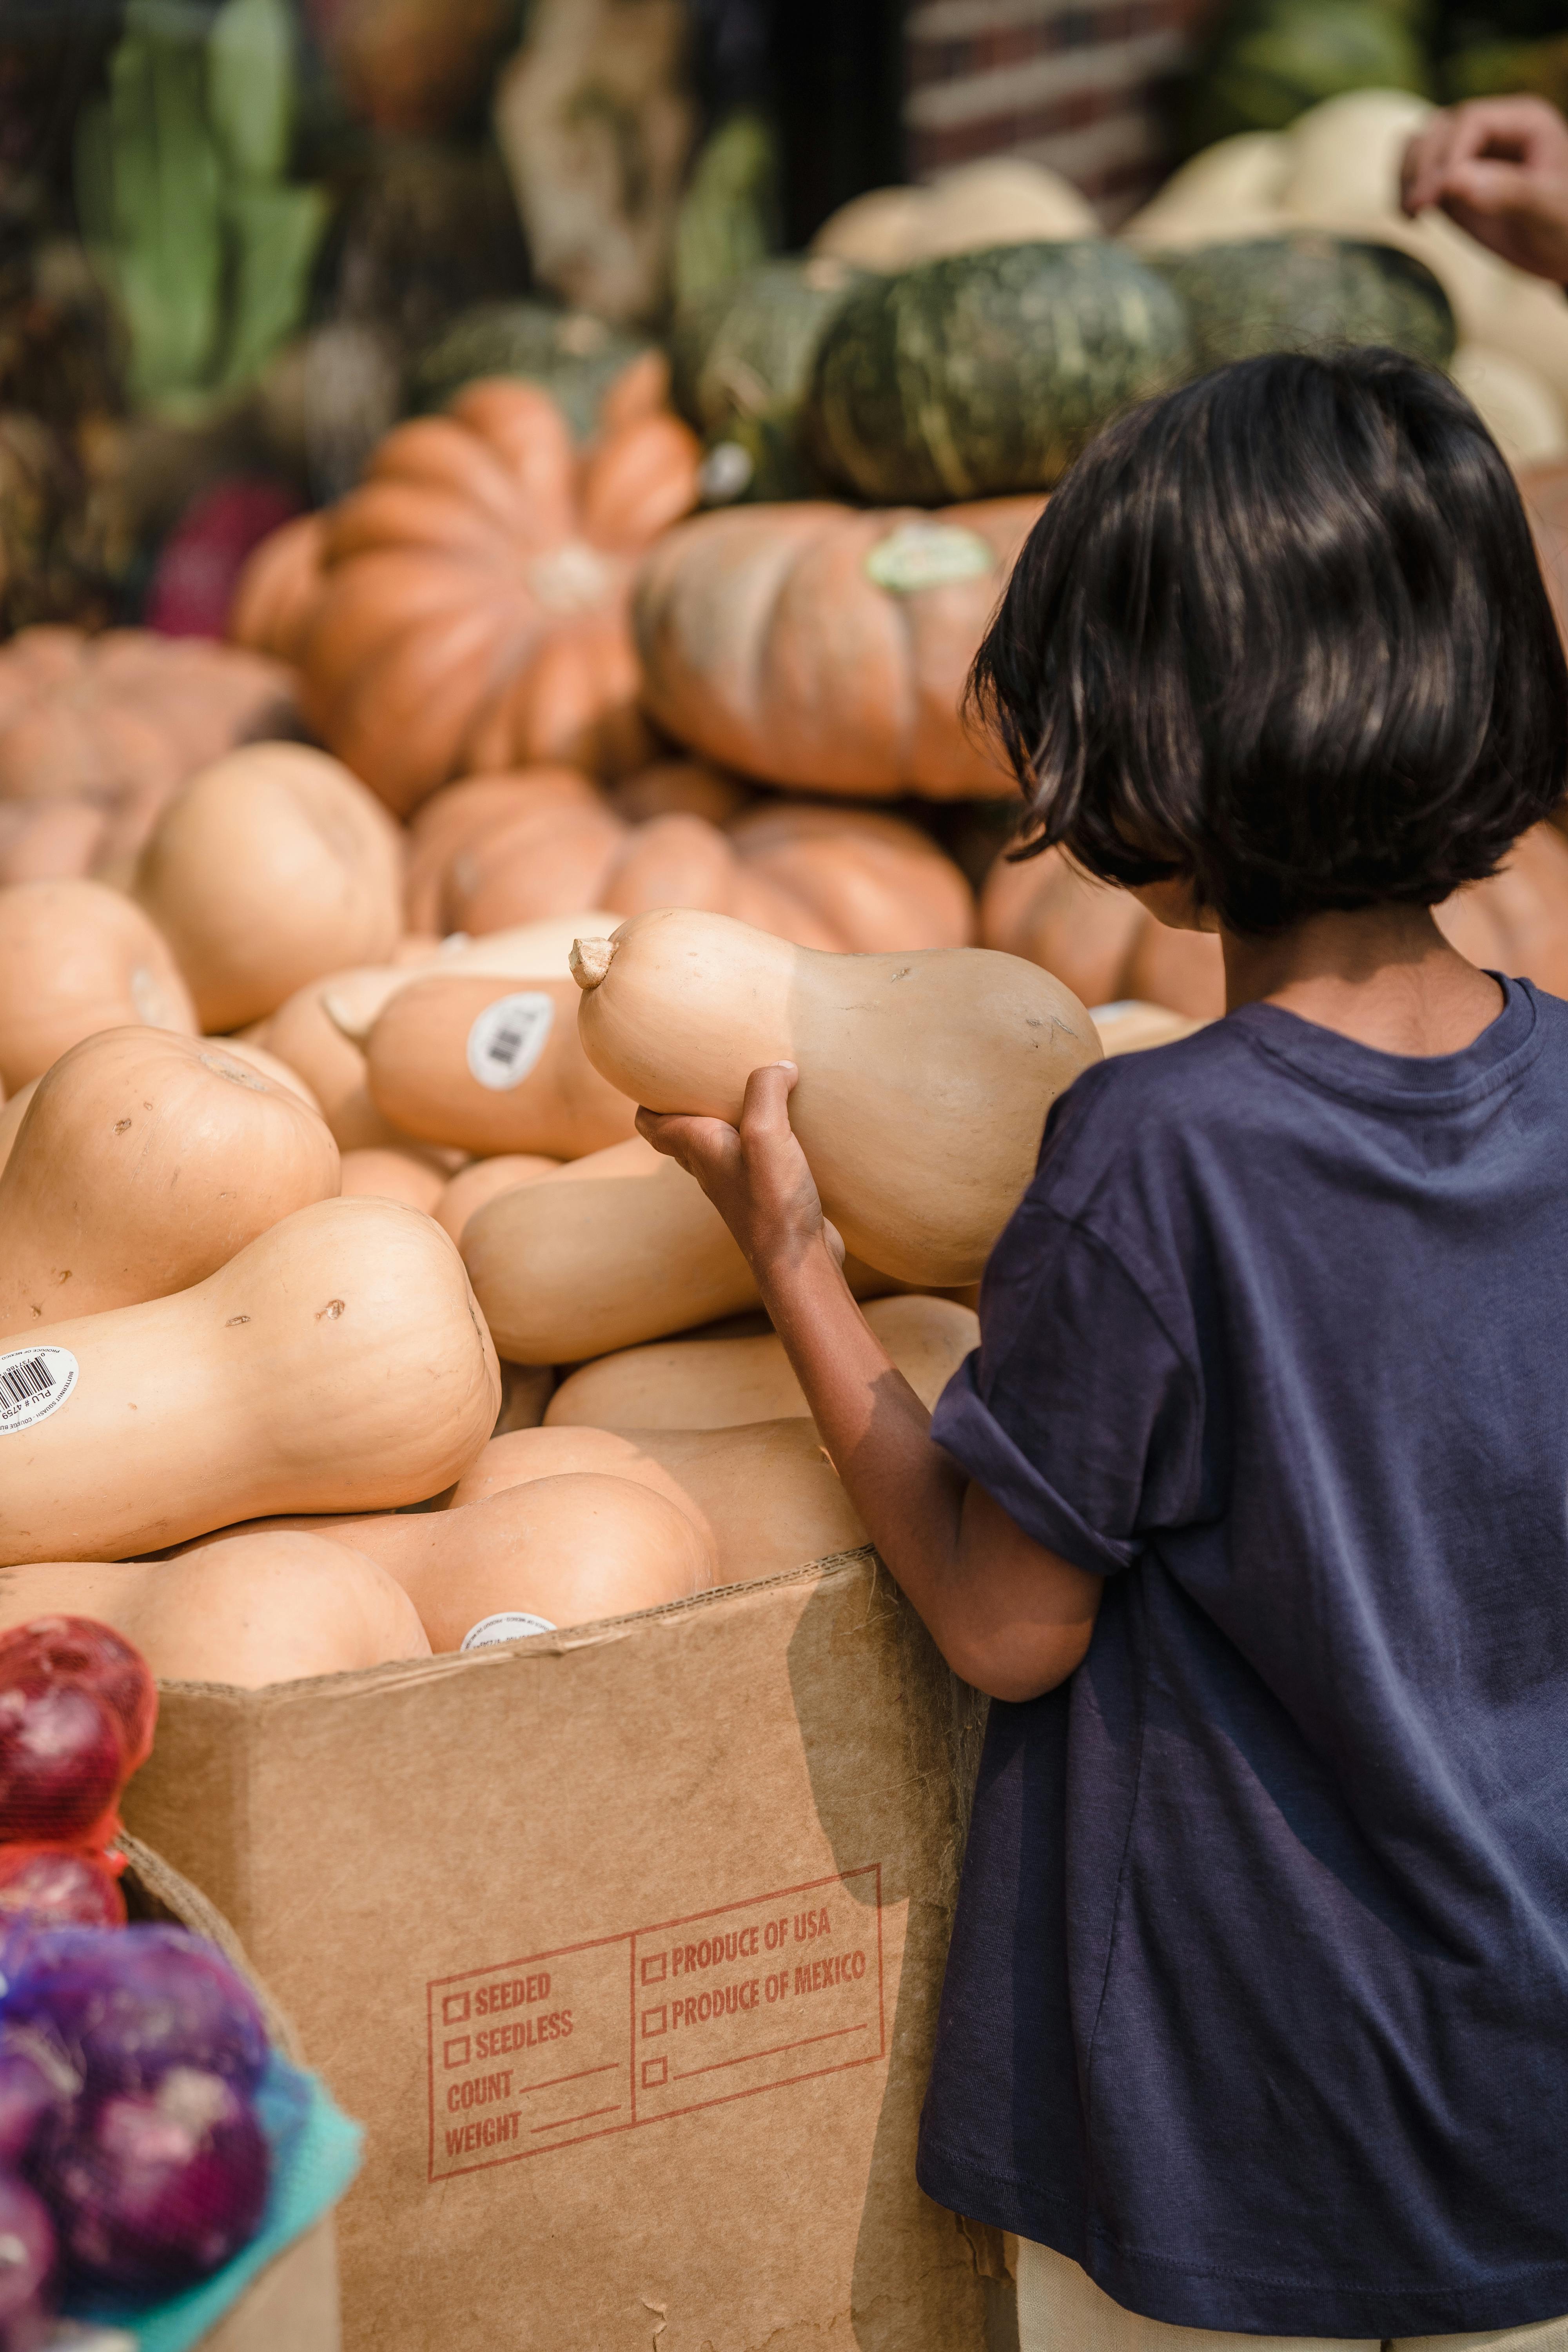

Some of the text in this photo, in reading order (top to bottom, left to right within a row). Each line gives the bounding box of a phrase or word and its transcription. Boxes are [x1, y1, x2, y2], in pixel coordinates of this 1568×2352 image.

[2, 1351, 23, 1360] MEXICO
[6, 1359, 31, 1372] 737186
[32, 1390, 51, 1404] PLU
[56, 1371, 74, 1402] BUTTERNUT
[2, 1404, 22, 1419] 4759
[36, 1401, 56, 1418] SQUASH
[672, 1907, 831, 1977] PRODUCE OF USA
[475, 1972, 551, 2016] SEEDED
[672, 1950, 866, 2029] PRODUCE OF MEXICO
[475, 2009, 573, 2060] SEEDLESS
[447, 2069, 514, 2113] COUNT
[445, 2111, 522, 2157] WEIGHT
